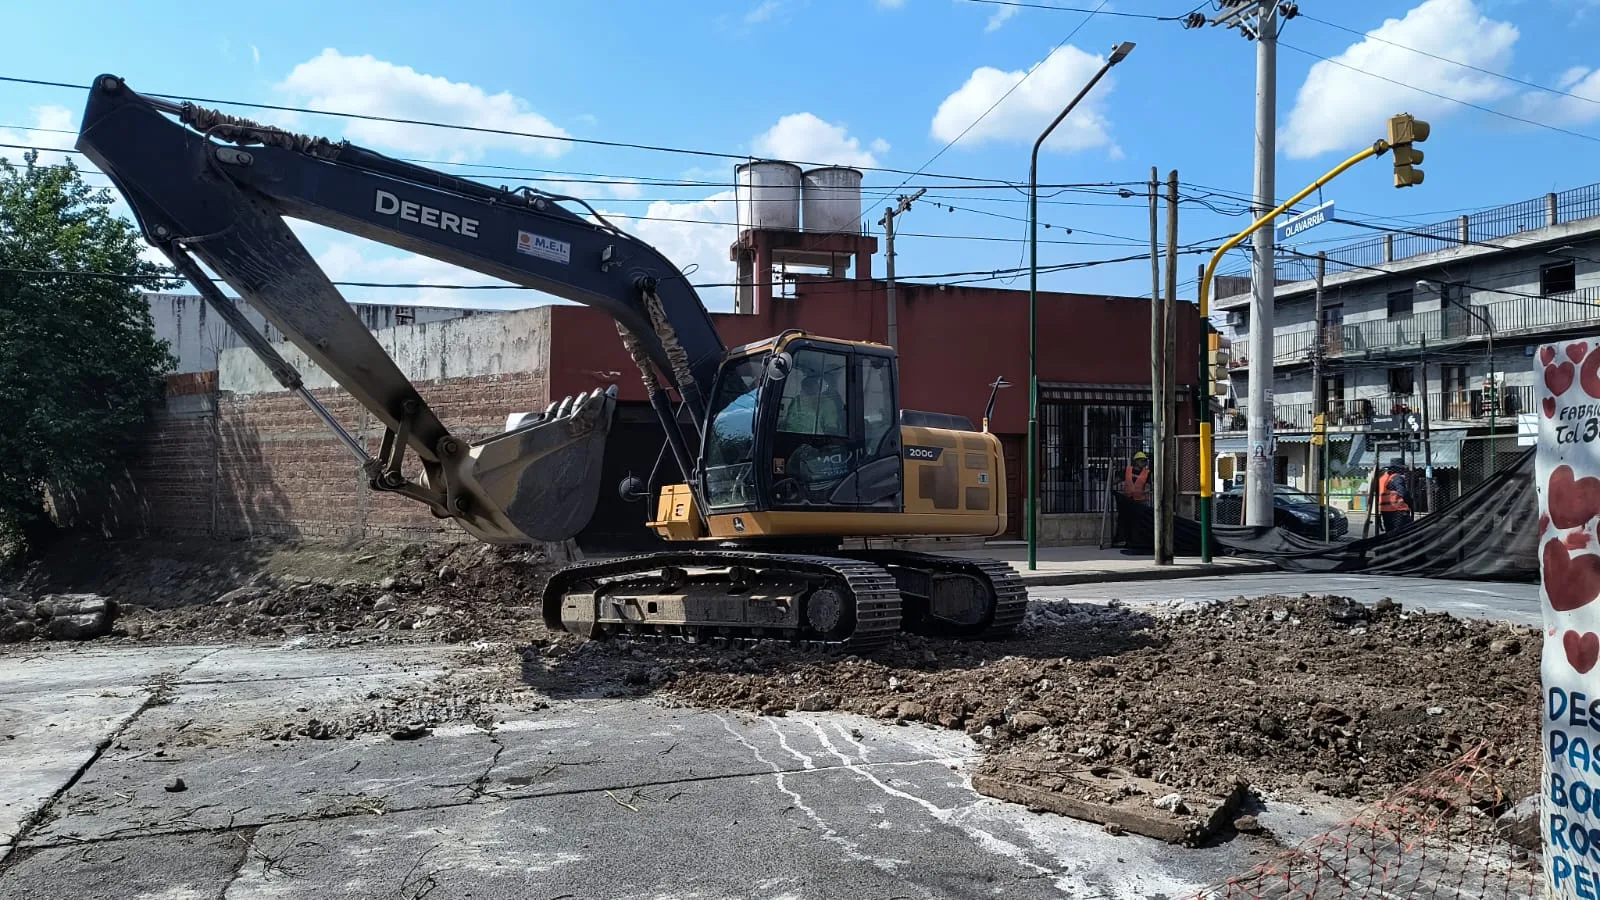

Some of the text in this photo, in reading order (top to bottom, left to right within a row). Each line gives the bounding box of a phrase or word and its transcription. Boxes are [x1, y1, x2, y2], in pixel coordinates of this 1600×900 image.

[375, 190, 479, 238] DEERE
[1285, 211, 1325, 237] OLAVARRÍA
[535, 237, 566, 254] M.E.I.
[1556, 417, 1600, 444] Tel 3
[909, 448, 933, 458] 200G
[1549, 687, 1600, 732] DES
